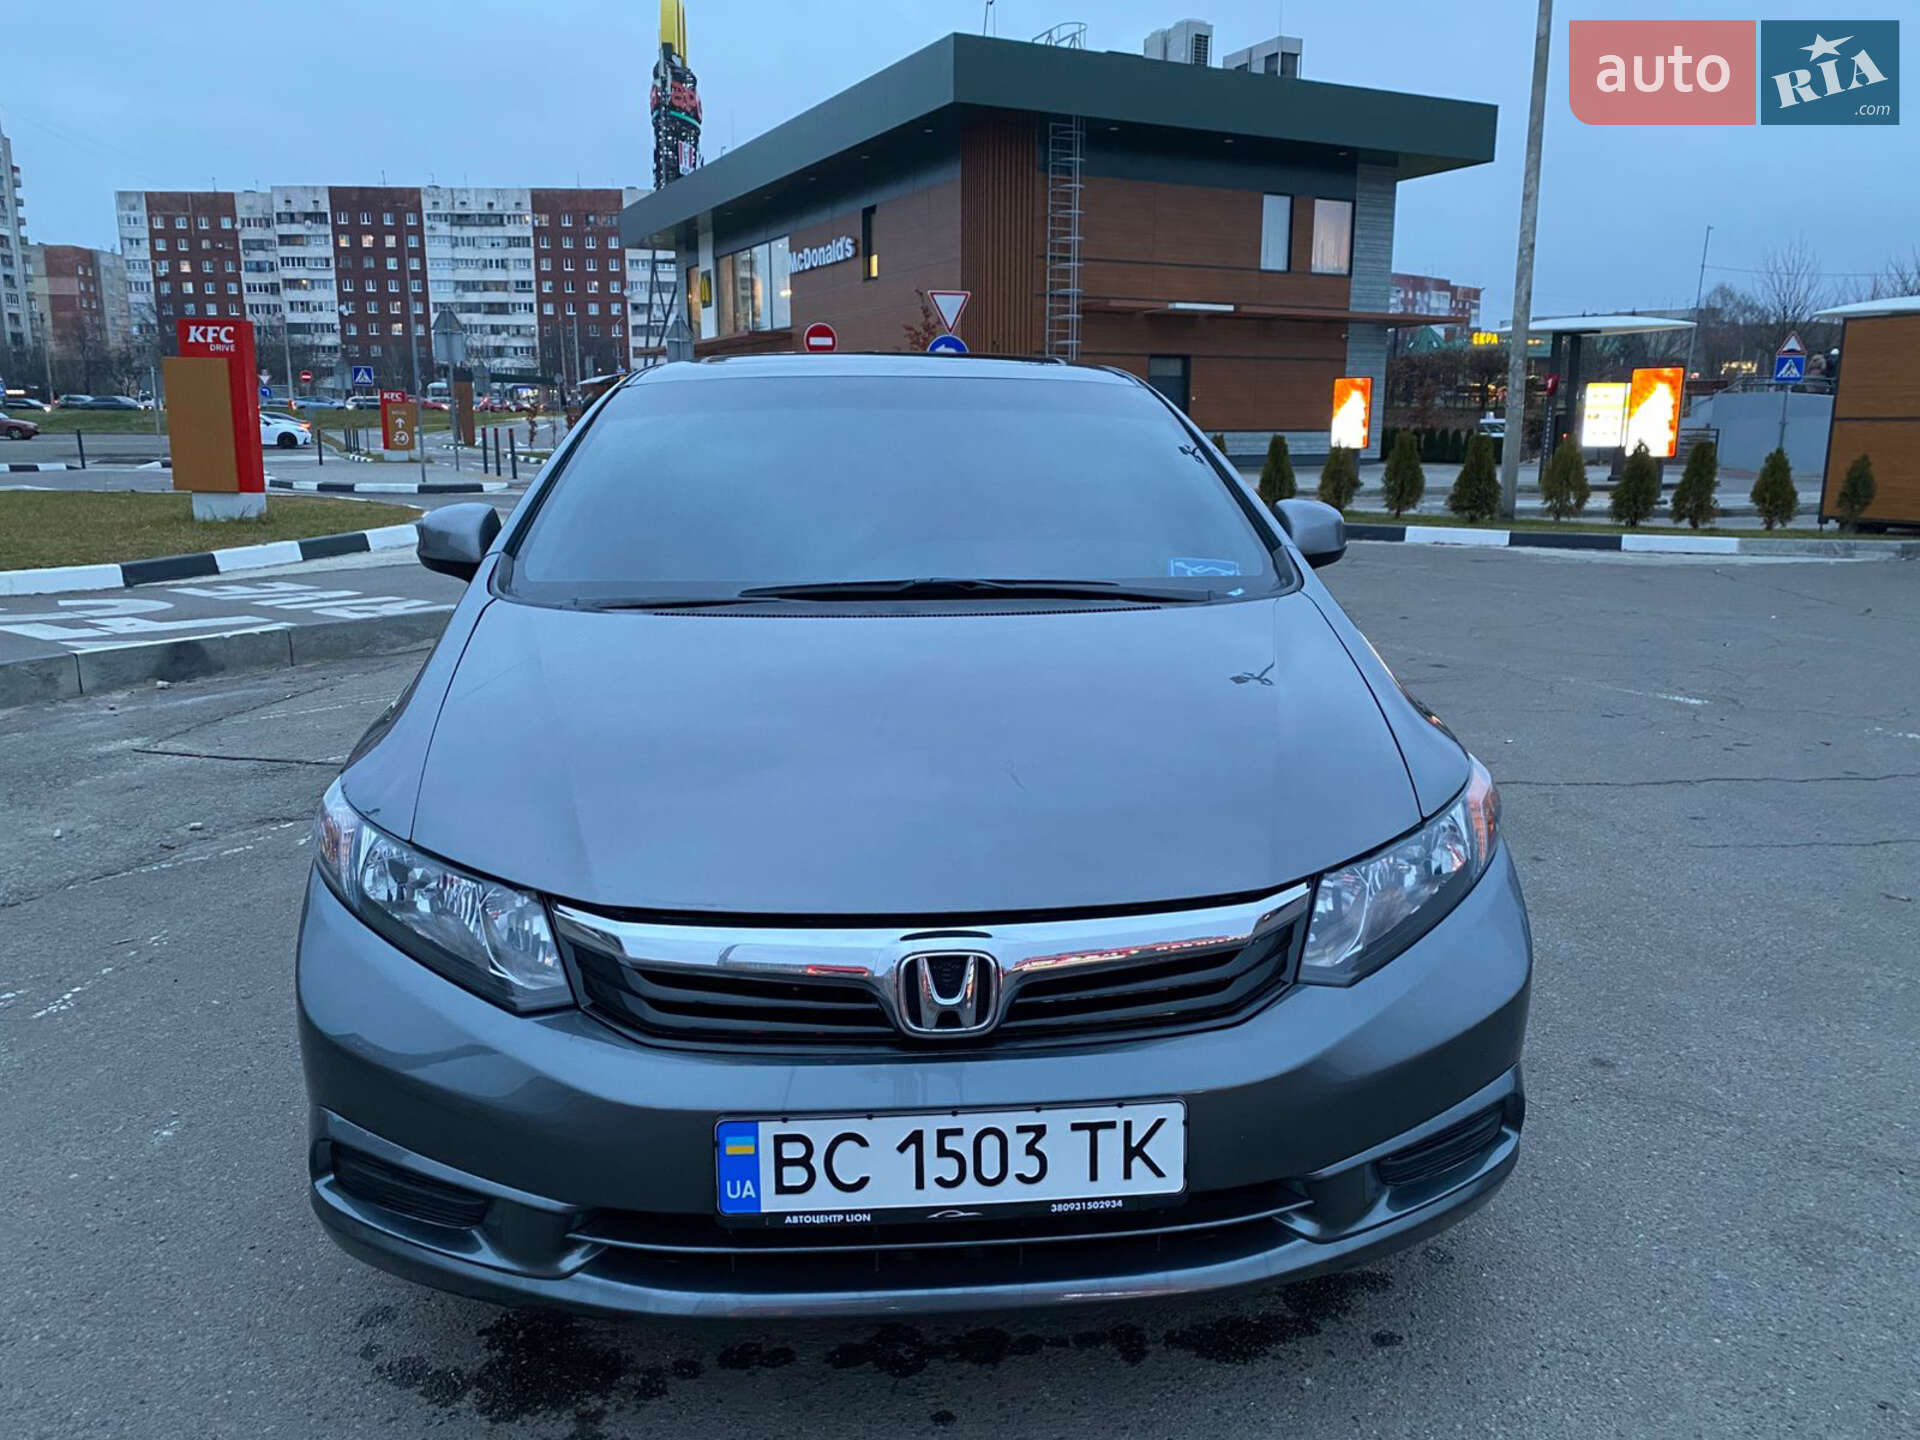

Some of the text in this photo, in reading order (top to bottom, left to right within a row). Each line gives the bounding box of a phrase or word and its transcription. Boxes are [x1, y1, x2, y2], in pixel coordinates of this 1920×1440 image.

[789, 235, 854, 273] McDonald's
[188, 325, 235, 343] KFC
[209, 344, 236, 352] DRIVE
[383, 392, 403, 402] KFC
[167, 581, 457, 619] RIVE
[773, 1117, 1168, 1196] BC 1503 TK
[726, 1180, 756, 1198] UA
[784, 1213, 871, 1224] АВТОЦЕНТР LION
